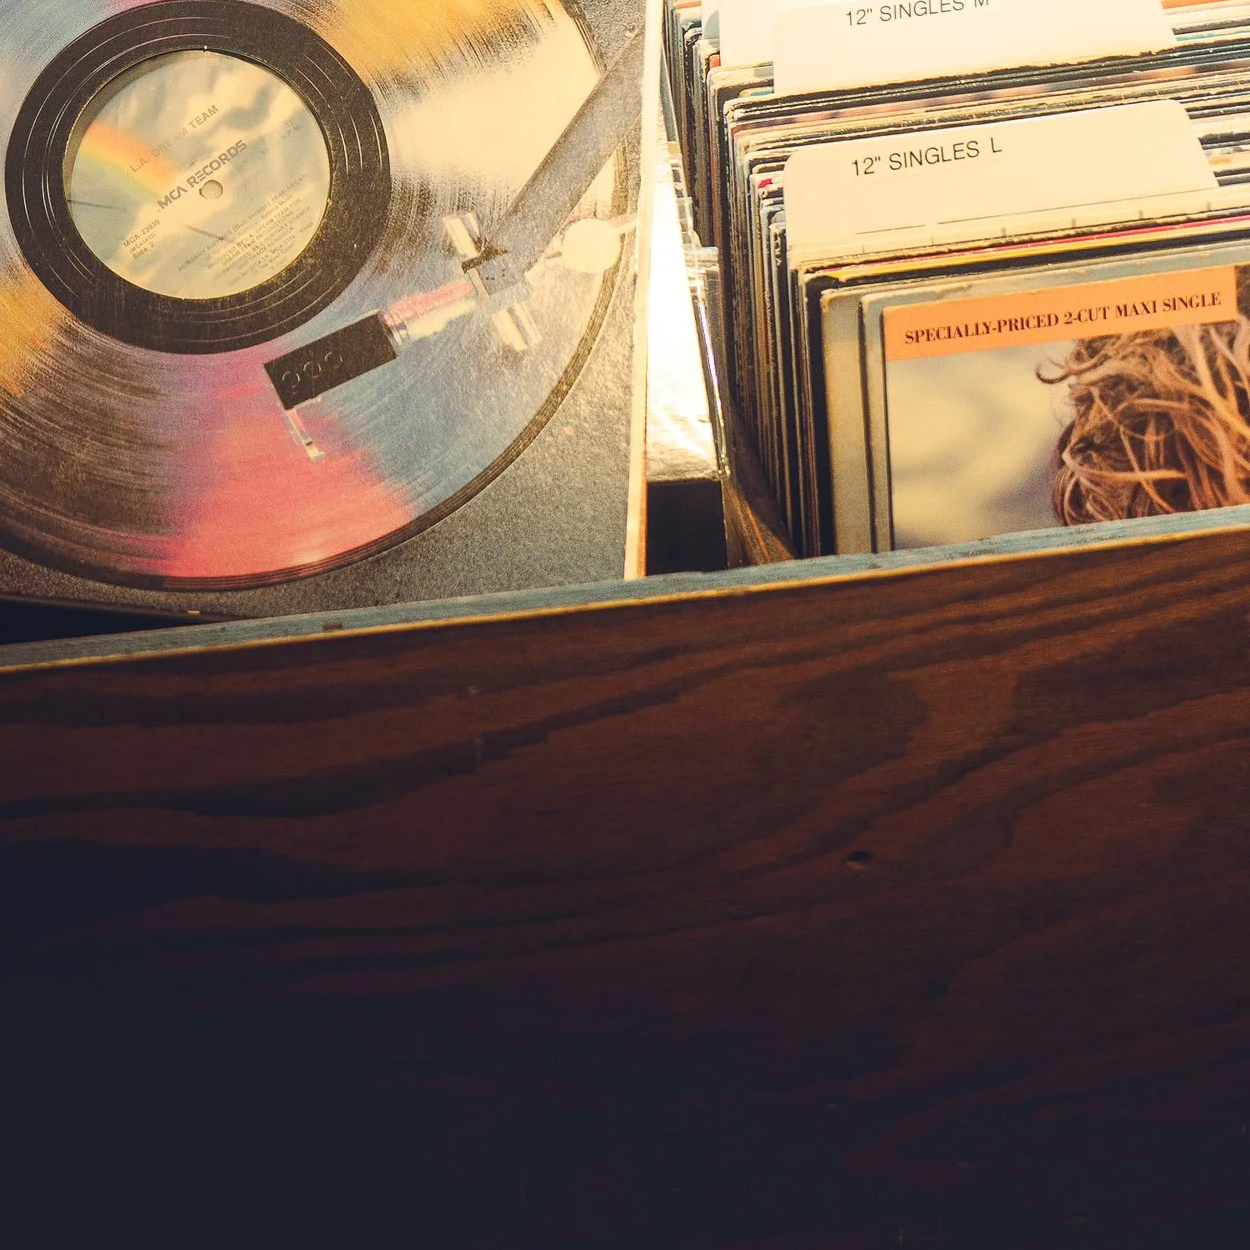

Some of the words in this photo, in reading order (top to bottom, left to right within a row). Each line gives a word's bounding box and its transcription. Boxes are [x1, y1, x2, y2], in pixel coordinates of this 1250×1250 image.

[846, 8, 873, 27] 12"
[149, 126, 188, 158] DREAM
[187, 103, 219, 130] TEAM
[851, 155, 881, 177] 12"
[888, 140, 980, 172] SINGLES
[989, 136, 1003, 154] L
[156, 184, 187, 209] MCA
[185, 139, 248, 188] RECORDS
[904, 312, 1059, 345] SPECIALLY-PRICED
[1063, 305, 1110, 326] 2-CUT
[1114, 301, 1157, 318] MAXI
[1161, 291, 1222, 313] SINGLE
